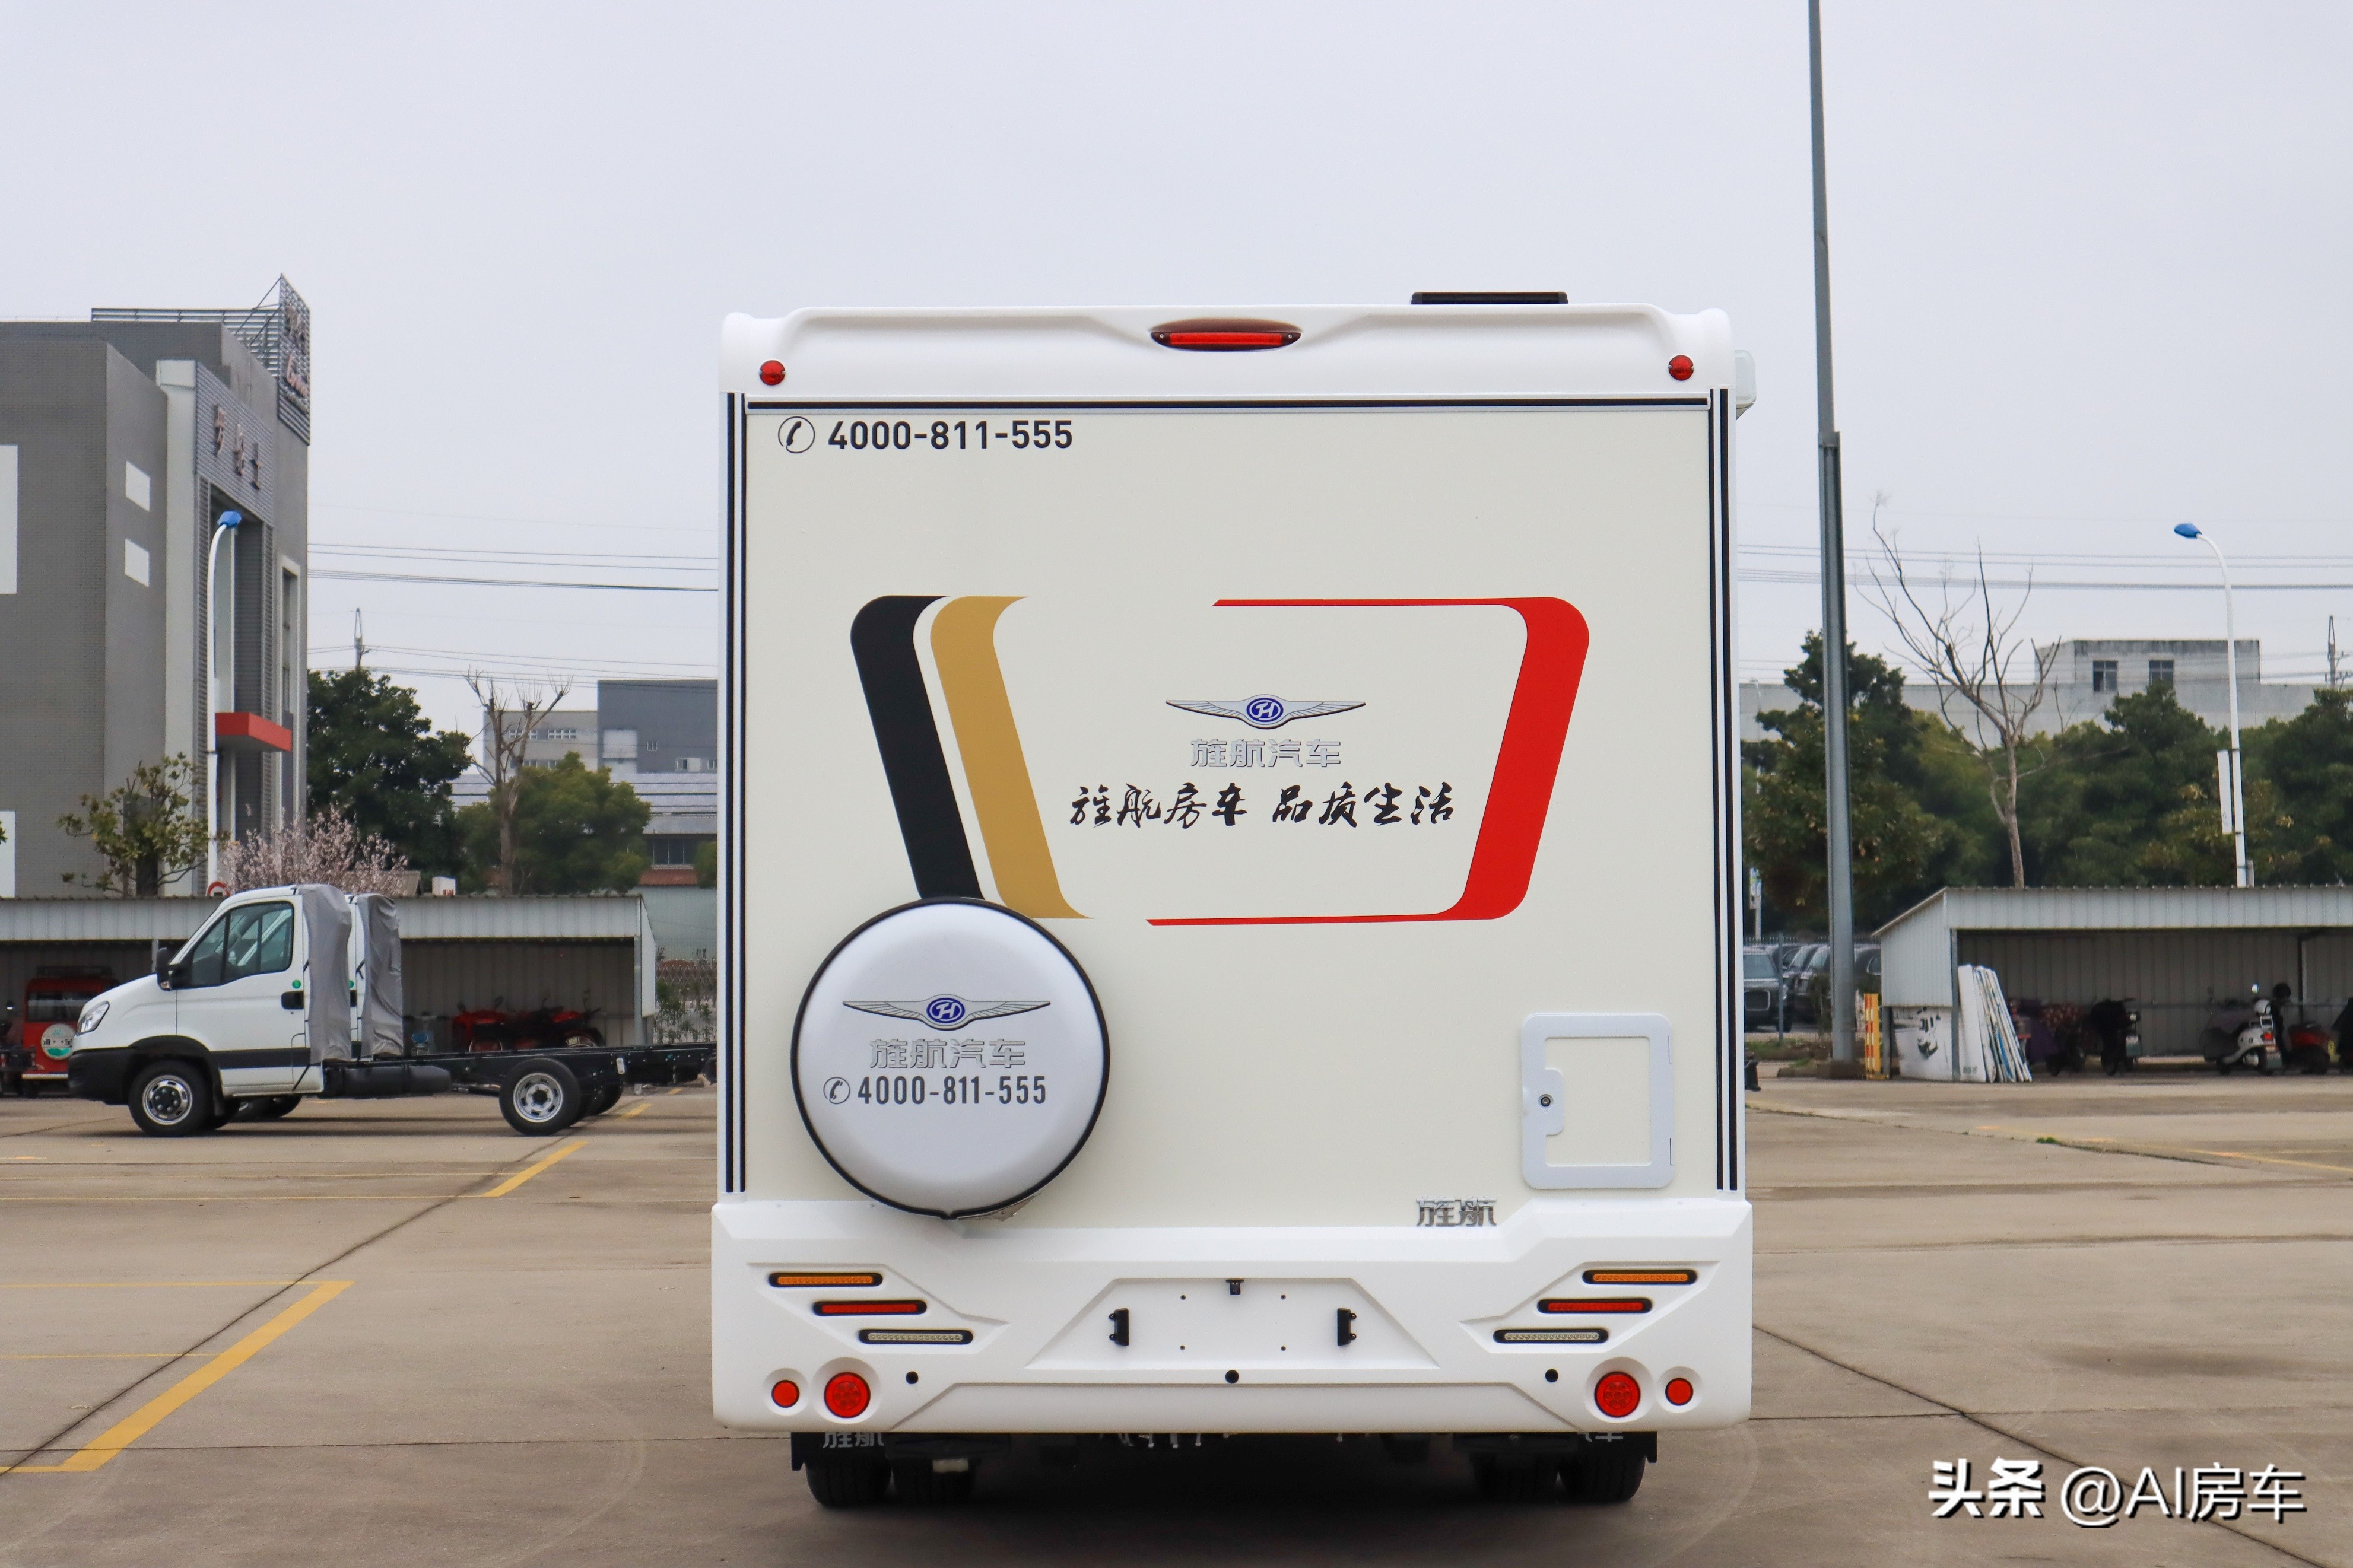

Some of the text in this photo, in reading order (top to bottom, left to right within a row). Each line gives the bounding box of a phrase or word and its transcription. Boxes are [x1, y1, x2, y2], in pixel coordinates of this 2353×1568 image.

[828, 420, 1072, 450] 4000-811-555
[1190, 739, 1341, 767] 旌航汽车
[1070, 781, 1454, 829] 旌航房车 品质生活
[869, 1039, 1025, 1068] 旌航汽车
[858, 1076, 1046, 1105] 4000-811-555
[1416, 1196, 1497, 1227] 旌航
